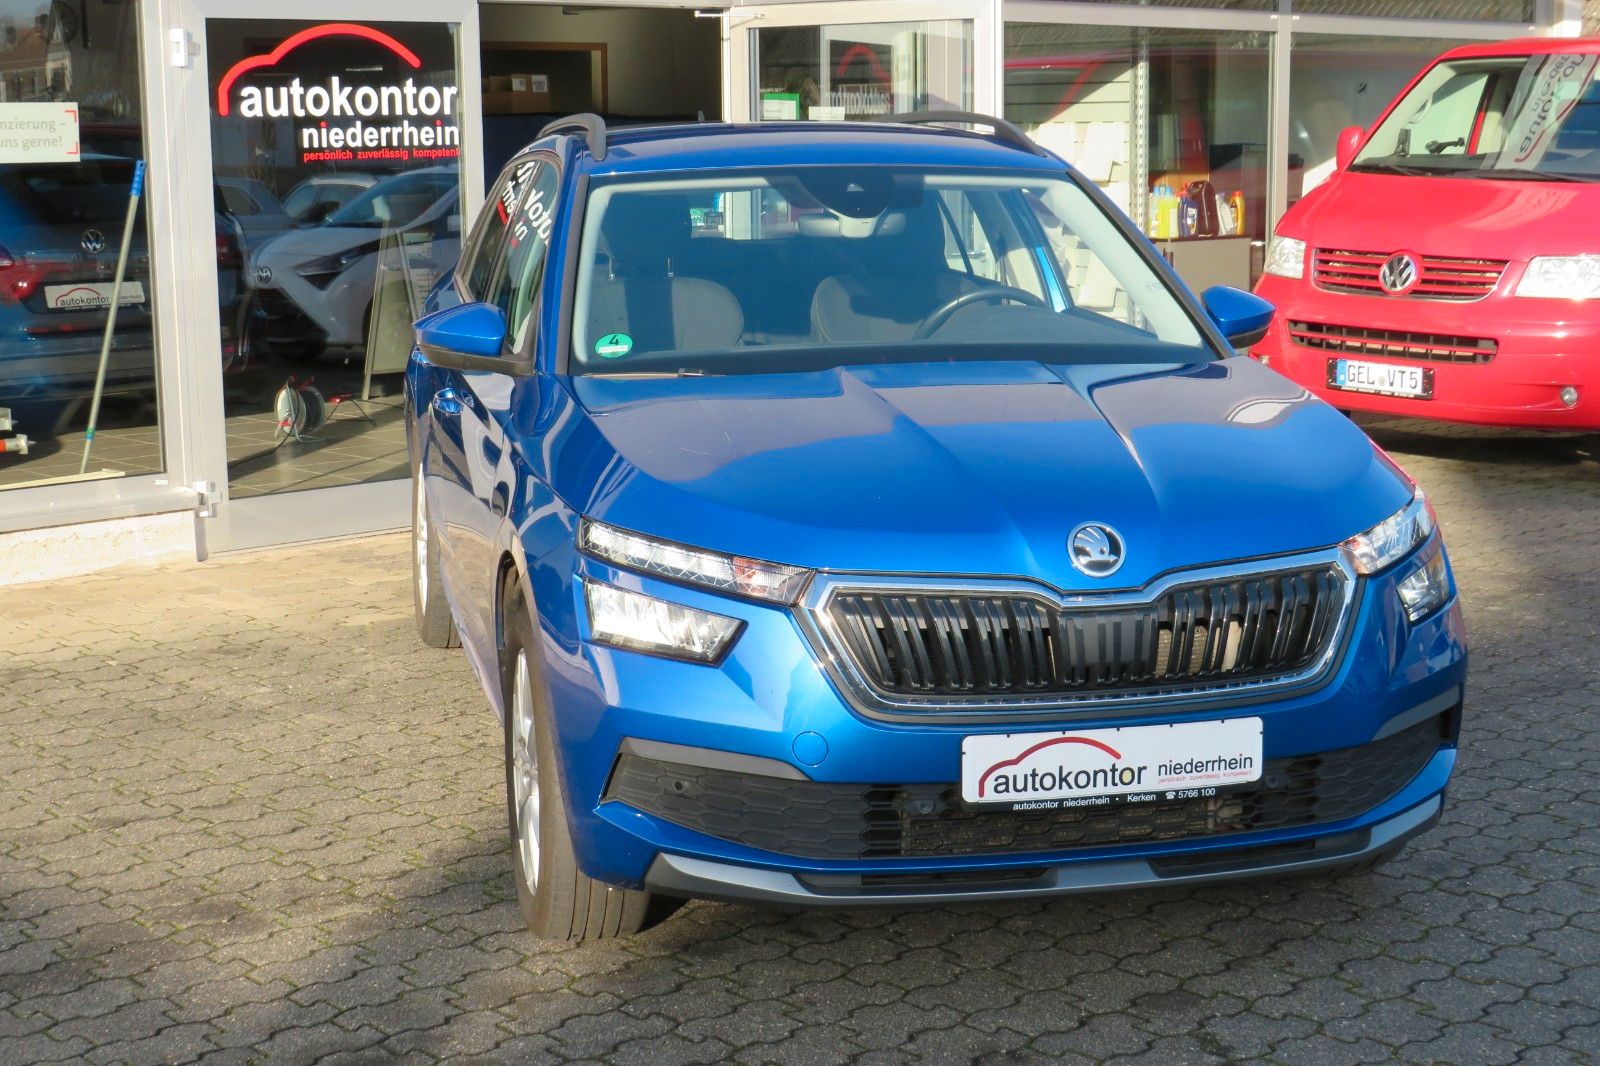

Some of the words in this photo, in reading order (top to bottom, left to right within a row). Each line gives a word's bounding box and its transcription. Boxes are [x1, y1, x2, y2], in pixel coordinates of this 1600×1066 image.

[239, 76, 458, 118] autokontor
[302, 120, 459, 148] niederrhein
[303, 150, 353, 163] persönlich
[357, 149, 409, 161] zuverlässig
[608, 334, 620, 346] 4
[1347, 364, 1375, 385] GEL
[993, 763, 1148, 794] autokontor
[1158, 753, 1253, 777] niederrhein
[1012, 801, 1059, 811] autokontor
[1063, 796, 1110, 807] niederrhein
[1127, 793, 1156, 802] Kerken
[1178, 791, 1199, 799] 5766
[1201, 788, 1216, 796] 100
